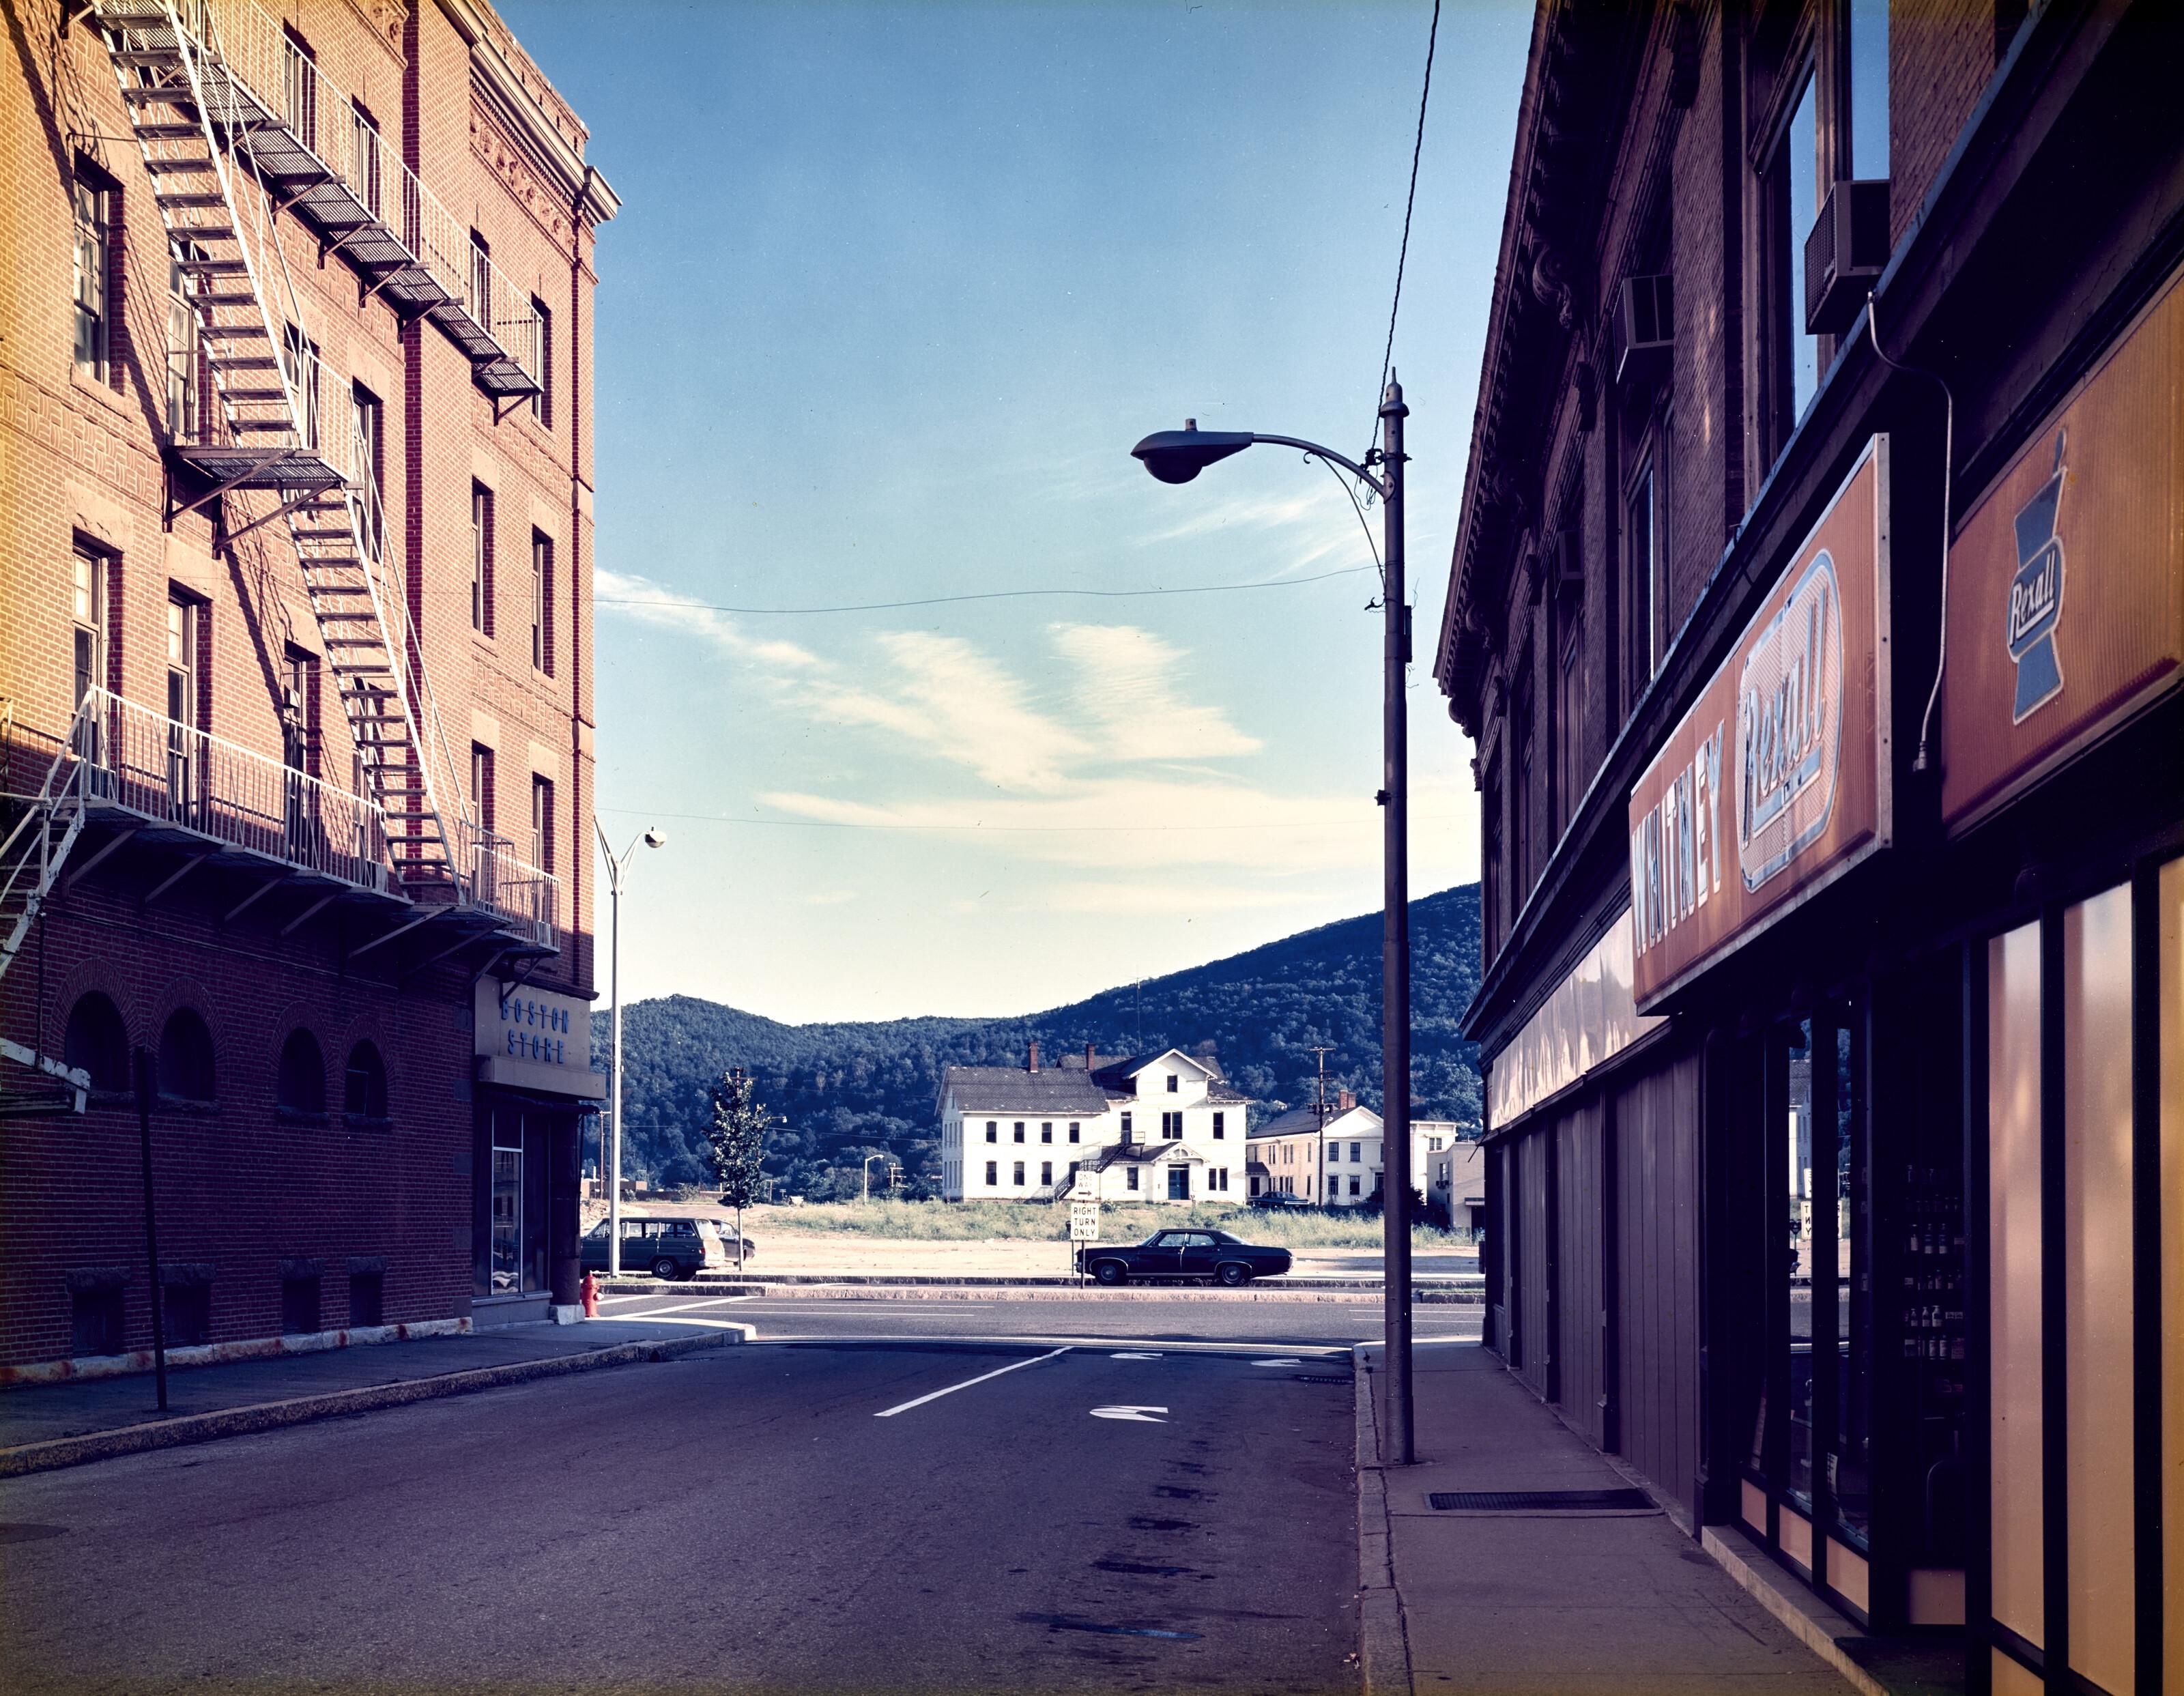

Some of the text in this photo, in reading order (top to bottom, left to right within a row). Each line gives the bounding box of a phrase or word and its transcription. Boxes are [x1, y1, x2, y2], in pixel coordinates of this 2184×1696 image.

[2009, 548, 2056, 647] Rexall
[1631, 586, 1828, 959] WHITNEY Rexall
[502, 998, 568, 1034] BOSTON
[508, 1029, 564, 1064] STORE
[1074, 1207, 1096, 1215] RIGHT
[1074, 1218, 1095, 1226] TURN
[1074, 1228, 1095, 1237] ONLY
